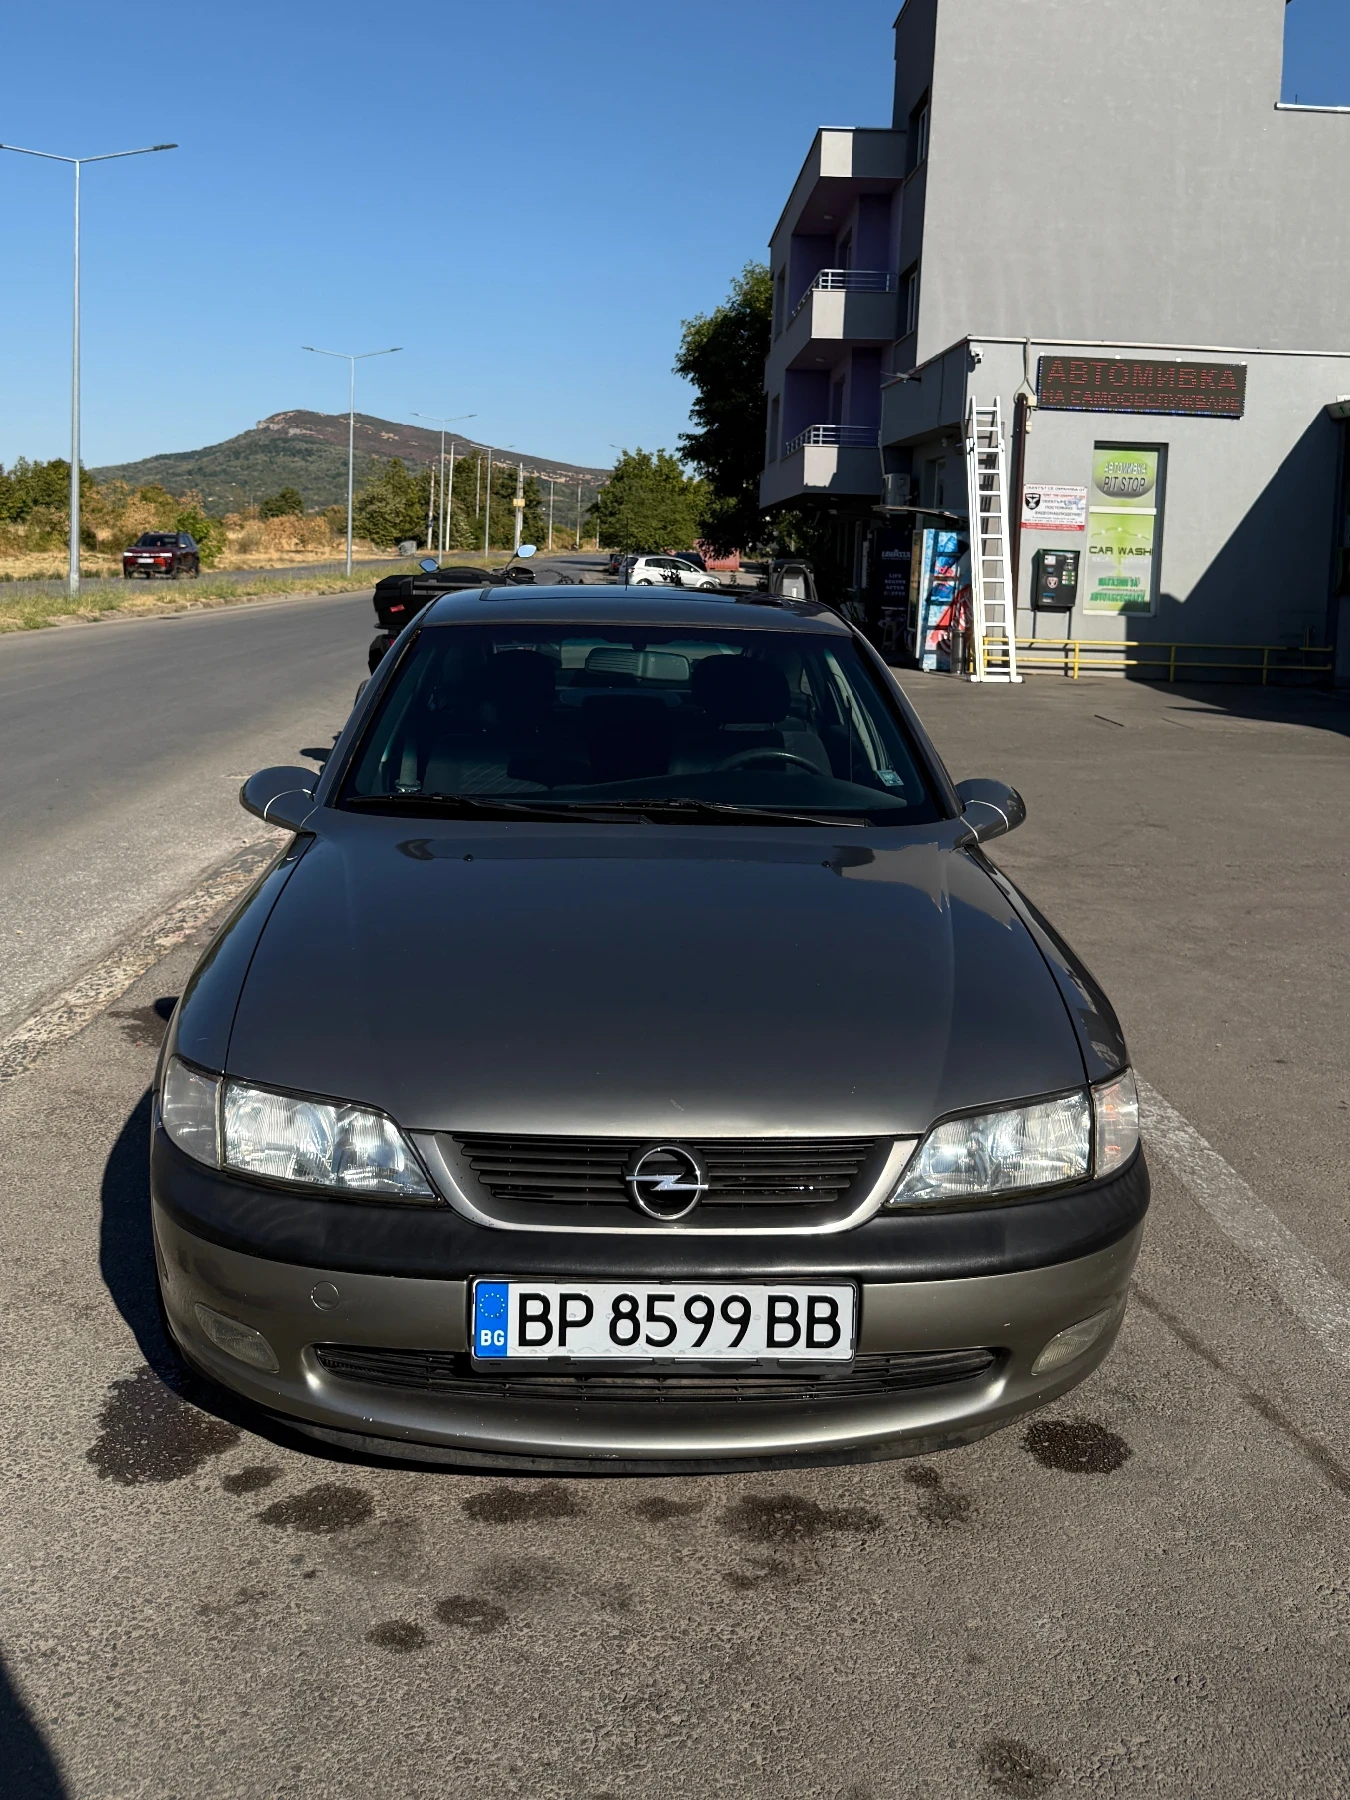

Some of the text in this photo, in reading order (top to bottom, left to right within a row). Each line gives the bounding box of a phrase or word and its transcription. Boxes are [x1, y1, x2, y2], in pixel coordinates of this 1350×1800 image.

[1046, 360, 1237, 390] АВТОМИВКА
[1042, 389, 1065, 403] НА
[1103, 476, 1146, 492] PIT STOP
[1089, 546, 1154, 556] CAR WASH
[518, 1292, 841, 1349] BP 8599 BB
[480, 1329, 505, 1346] BG
